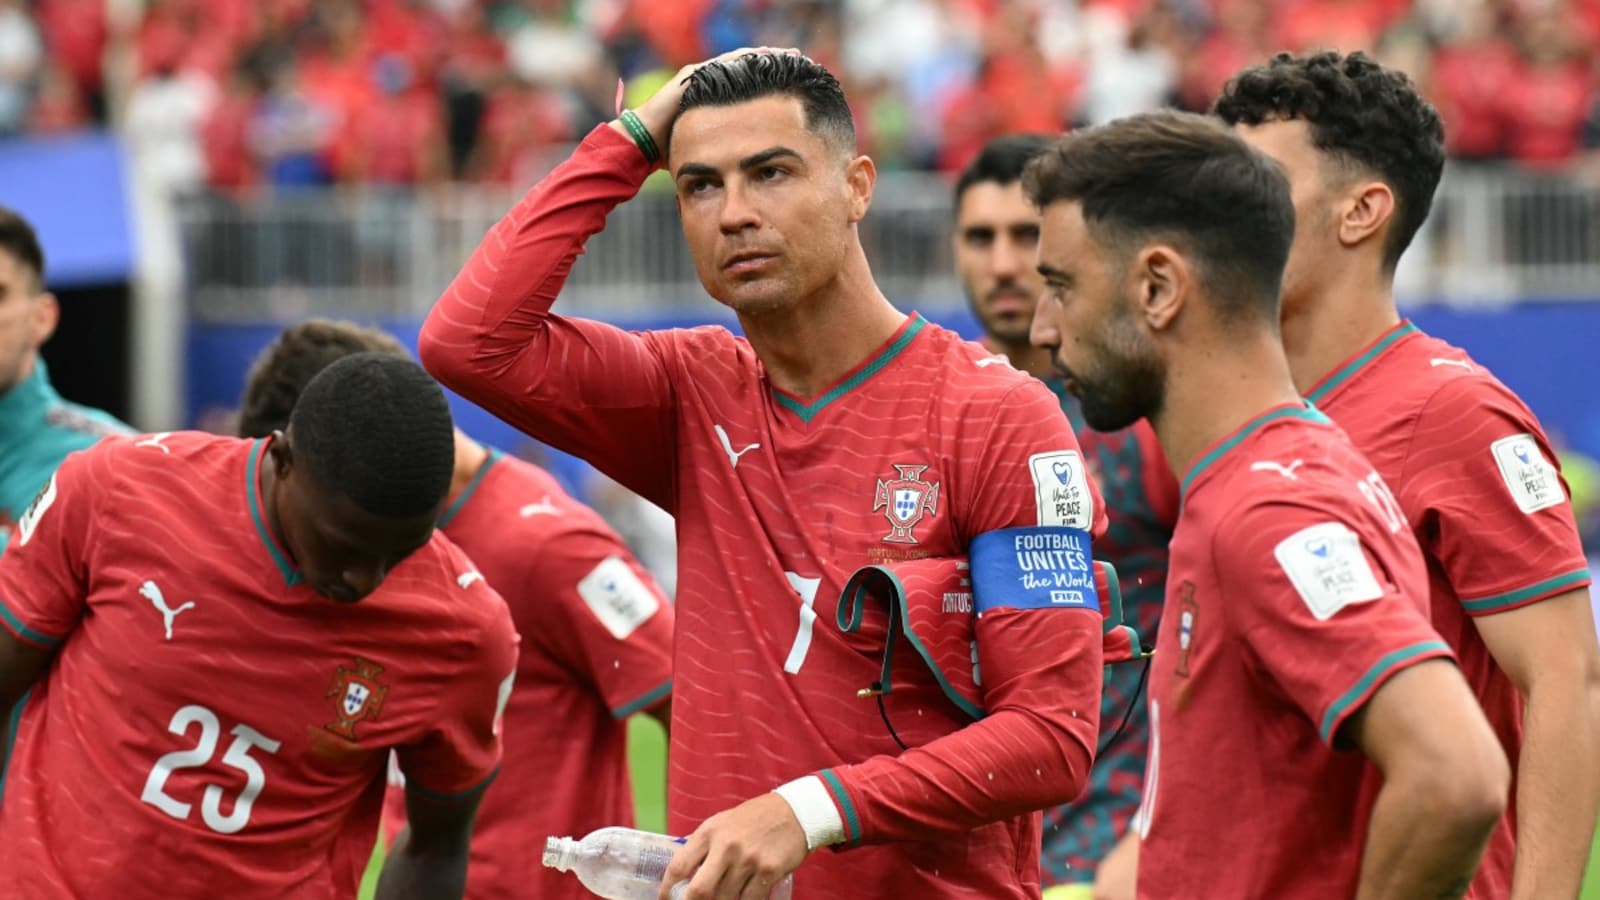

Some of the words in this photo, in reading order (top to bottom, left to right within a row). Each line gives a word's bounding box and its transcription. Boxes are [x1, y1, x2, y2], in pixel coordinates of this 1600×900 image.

[1055, 502, 1081, 517] PEACE
[1015, 535, 1082, 551] FOOTBALL
[1017, 550, 1089, 572] UNITES
[1018, 571, 1052, 590] the
[1052, 571, 1095, 592] World
[1053, 592, 1082, 602] FIFA
[784, 571, 822, 675] 7
[141, 704, 282, 835] 25
